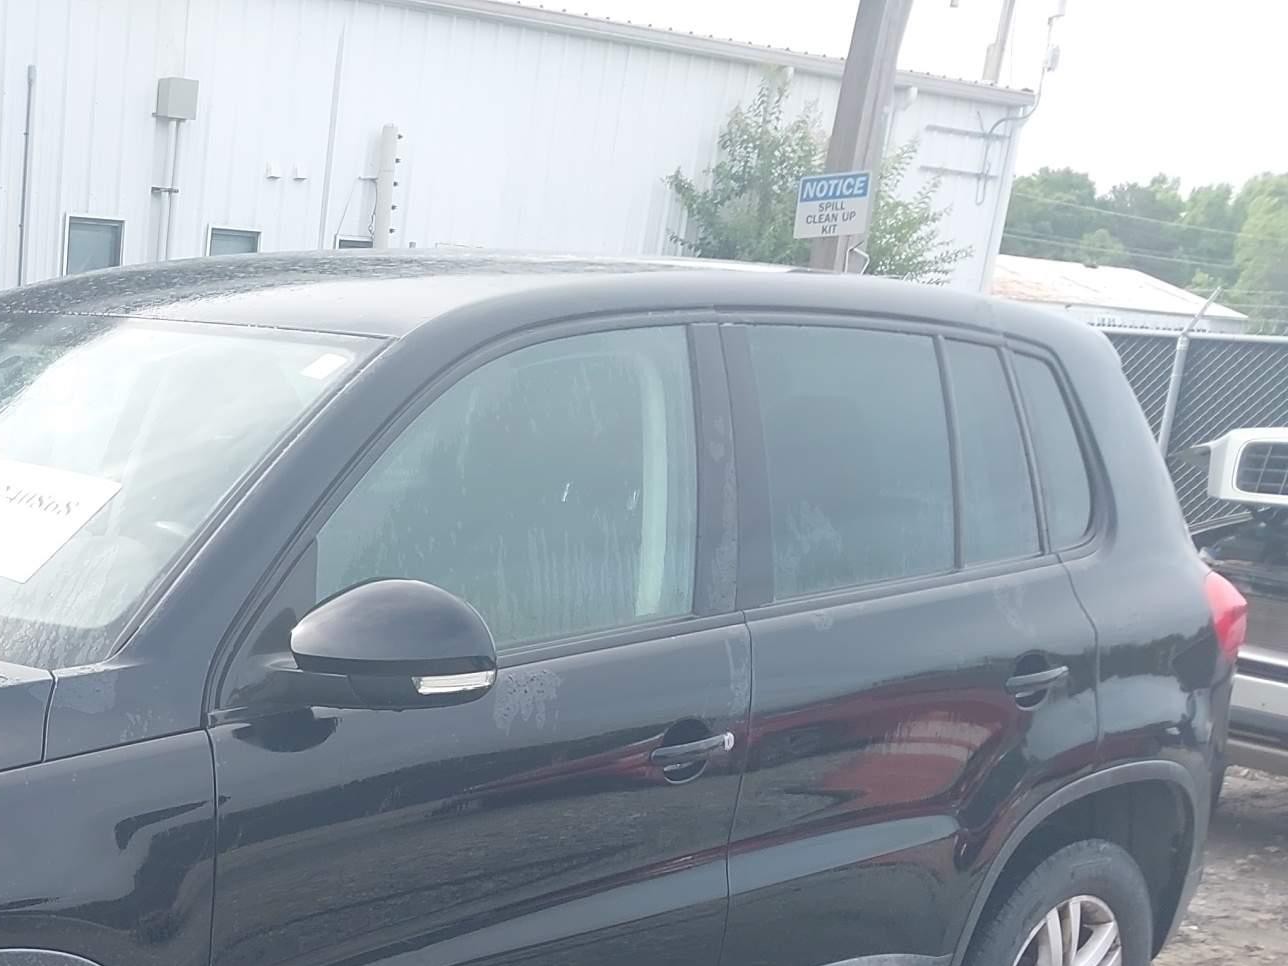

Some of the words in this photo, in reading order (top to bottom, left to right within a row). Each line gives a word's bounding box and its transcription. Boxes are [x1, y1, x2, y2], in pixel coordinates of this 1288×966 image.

[803, 176, 867, 199] NOTICE
[818, 201, 845, 212] SPILL
[806, 213, 838, 225] CLEAN
[842, 211, 856, 222] UP
[821, 224, 837, 235] KIT
